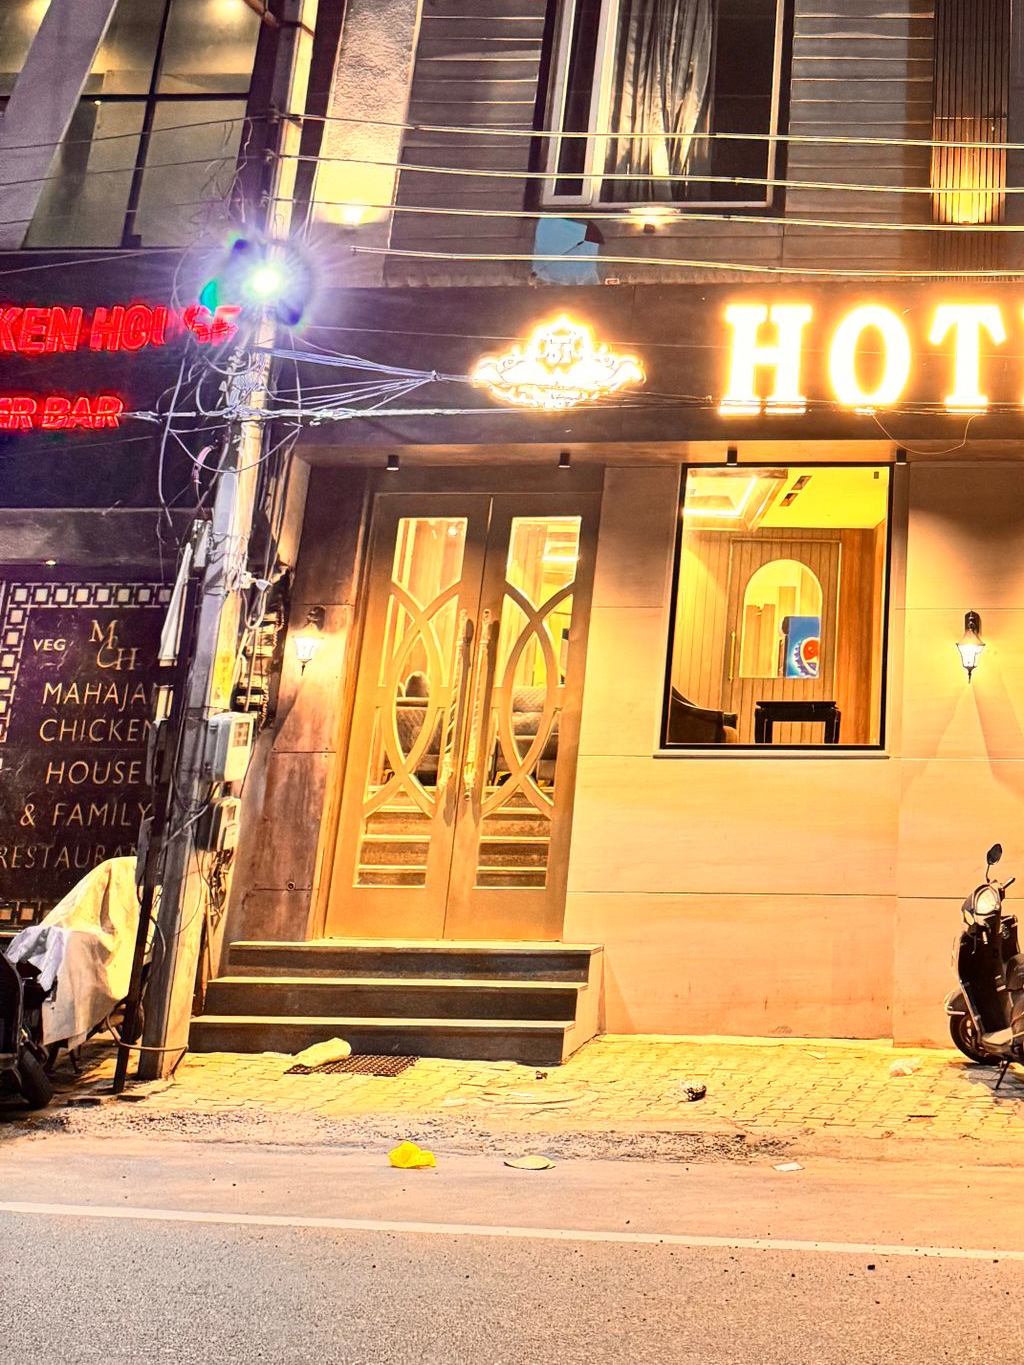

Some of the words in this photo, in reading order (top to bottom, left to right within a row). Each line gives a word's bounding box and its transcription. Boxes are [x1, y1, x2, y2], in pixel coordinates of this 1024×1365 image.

[42, 395, 124, 430] BAR
[33, 638, 66, 652] VEG
[45, 761, 142, 785] HOUSE
[19, 802, 36, 827] &
[53, 802, 153, 827] FAMILY
